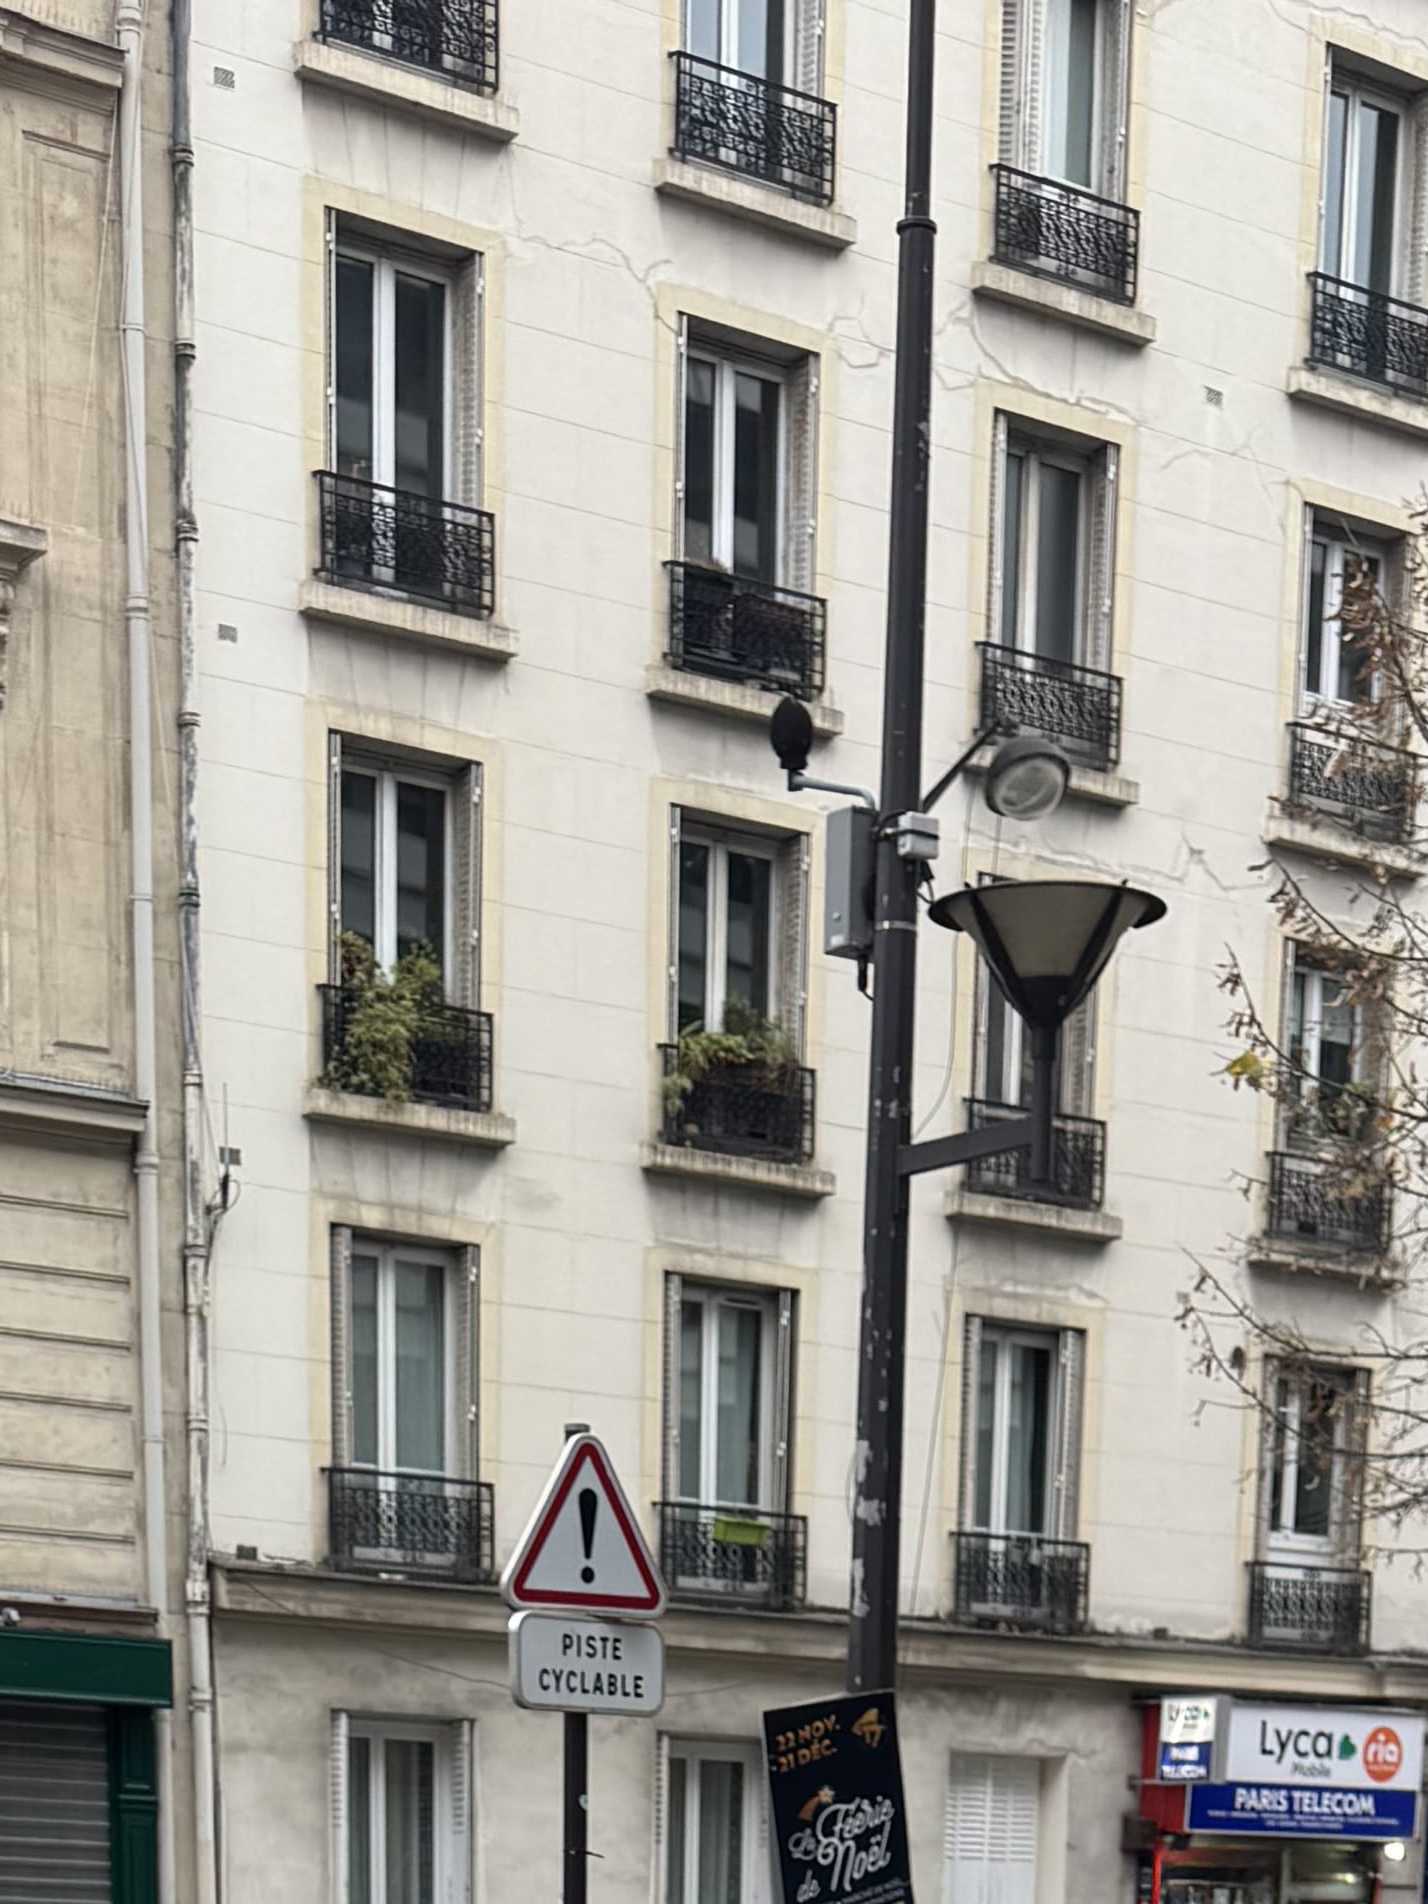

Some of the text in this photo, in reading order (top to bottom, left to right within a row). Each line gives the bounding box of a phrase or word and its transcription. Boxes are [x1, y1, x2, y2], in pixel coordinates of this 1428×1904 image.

[561, 1632, 623, 1661] PISTE
[538, 1667, 645, 1699] CYCLABLE
[797, 1713, 841, 1744] NOV.
[1260, 1718, 1334, 1765] Lyca
[796, 1737, 839, 1766] DÉC.
[1367, 1732, 1399, 1763] ria
[1290, 1760, 1333, 1779] Mobile
[1234, 1787, 1376, 1816] PARIS TELECOM
[817, 1820, 892, 1892] Noël
